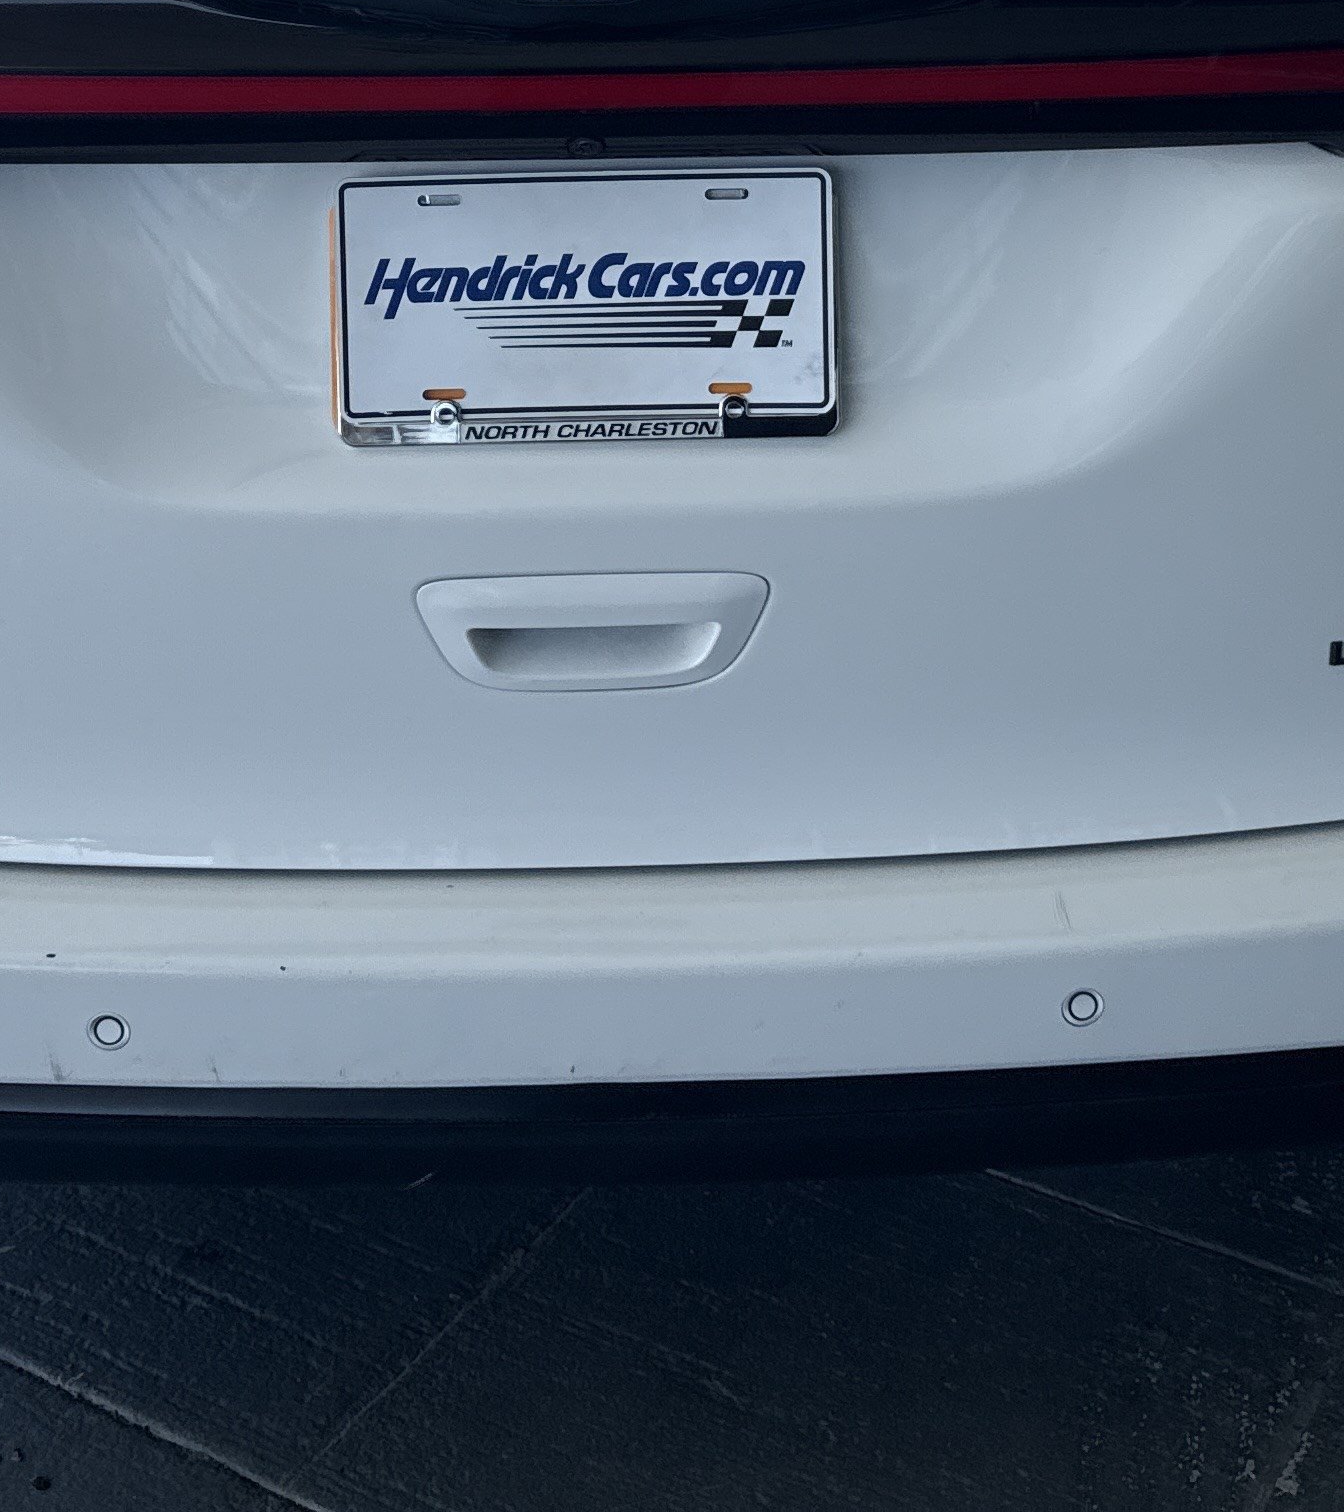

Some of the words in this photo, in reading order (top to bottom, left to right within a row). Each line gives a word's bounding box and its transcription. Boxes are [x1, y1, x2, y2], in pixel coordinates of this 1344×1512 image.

[364, 253, 586, 319] Hendrick
[588, 252, 806, 299] Cars.com
[465, 424, 551, 440] NORTH
[556, 421, 718, 438] CHARLESTON
